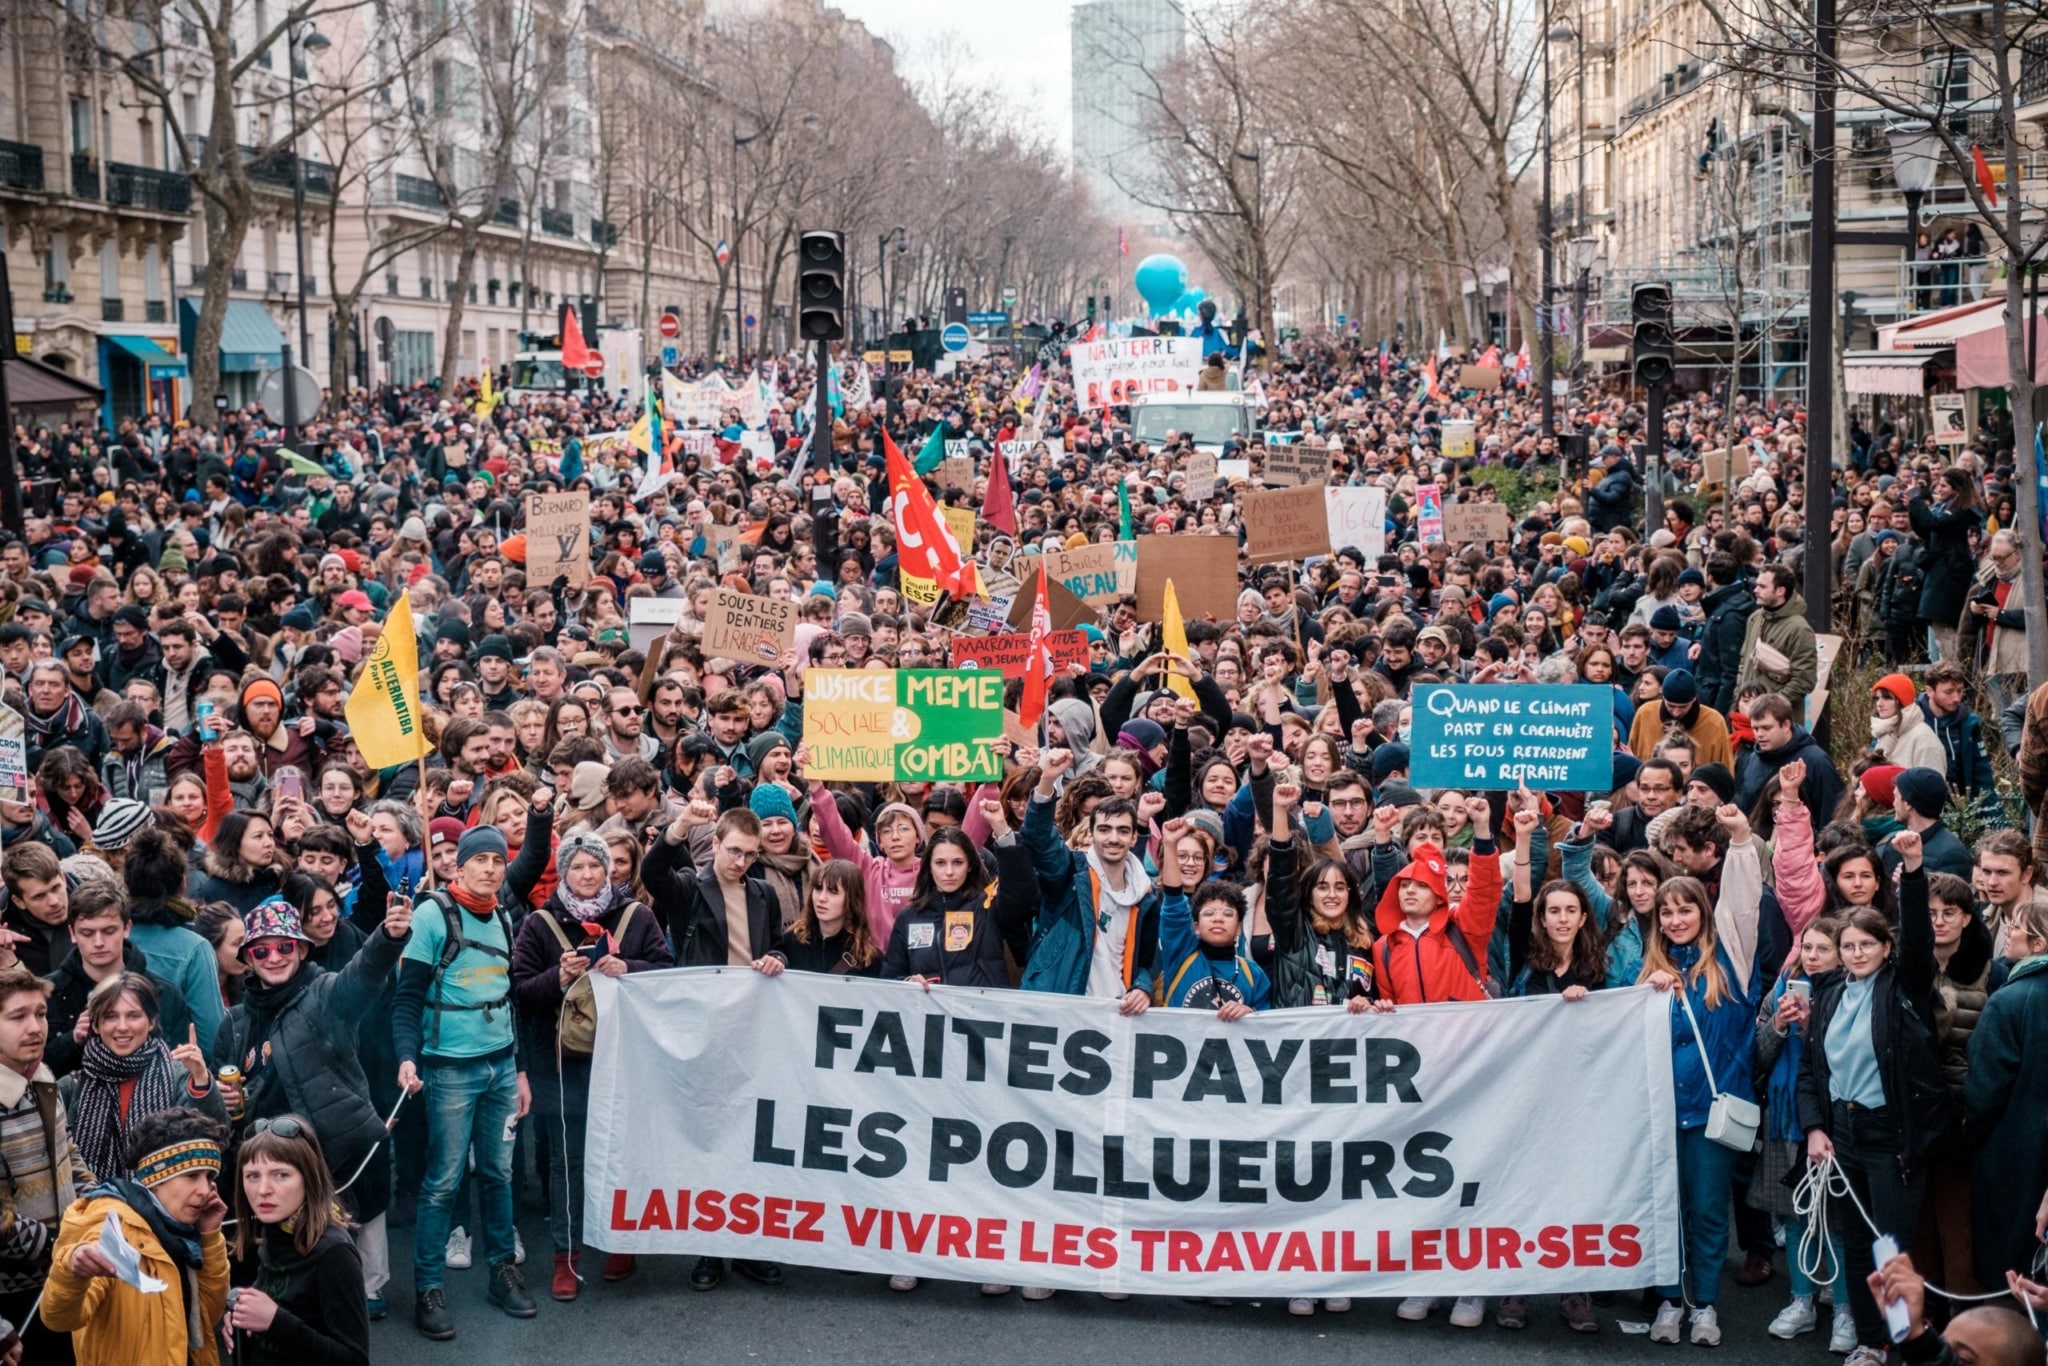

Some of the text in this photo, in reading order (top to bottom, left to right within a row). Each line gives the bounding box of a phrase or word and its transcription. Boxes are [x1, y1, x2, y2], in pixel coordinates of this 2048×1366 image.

[1088, 339, 1176, 361] NANTERRE
[532, 496, 583, 516] BERNARD
[530, 524, 582, 538] MILLIARDS
[1060, 554, 1105, 574] Boulot
[1064, 571, 1116, 600] BEAU
[718, 593, 789, 619] SOUS LES
[727, 611, 785, 633] DENTIERS
[713, 628, 760, 655] LA RAGE
[370, 664, 382, 690] Paris
[380, 660, 413, 736] ALTERNATIBA
[806, 674, 1000, 709] JUSTICE MEME
[1427, 688, 1500, 718] QUAND
[1504, 700, 1521, 714] LE
[809, 712, 888, 735] SOCIALE
[890, 708, 910, 738] &
[1444, 722, 1594, 739] PART EN CACAHUÈTE
[806, 737, 1000, 776] CLIMATIQUE COMBAT
[1430, 743, 1589, 760] LES FOUS RETARDENT
[1464, 763, 1487, 778] LA
[816, 1006, 1422, 1104] FAITES PAYER
[754, 1099, 1481, 1207] LES POLLUEURS,
[612, 1190, 825, 1242] LAISSEZ
[843, 1206, 1006, 1259] VIVRE
[1021, 1222, 1117, 1269] LES
